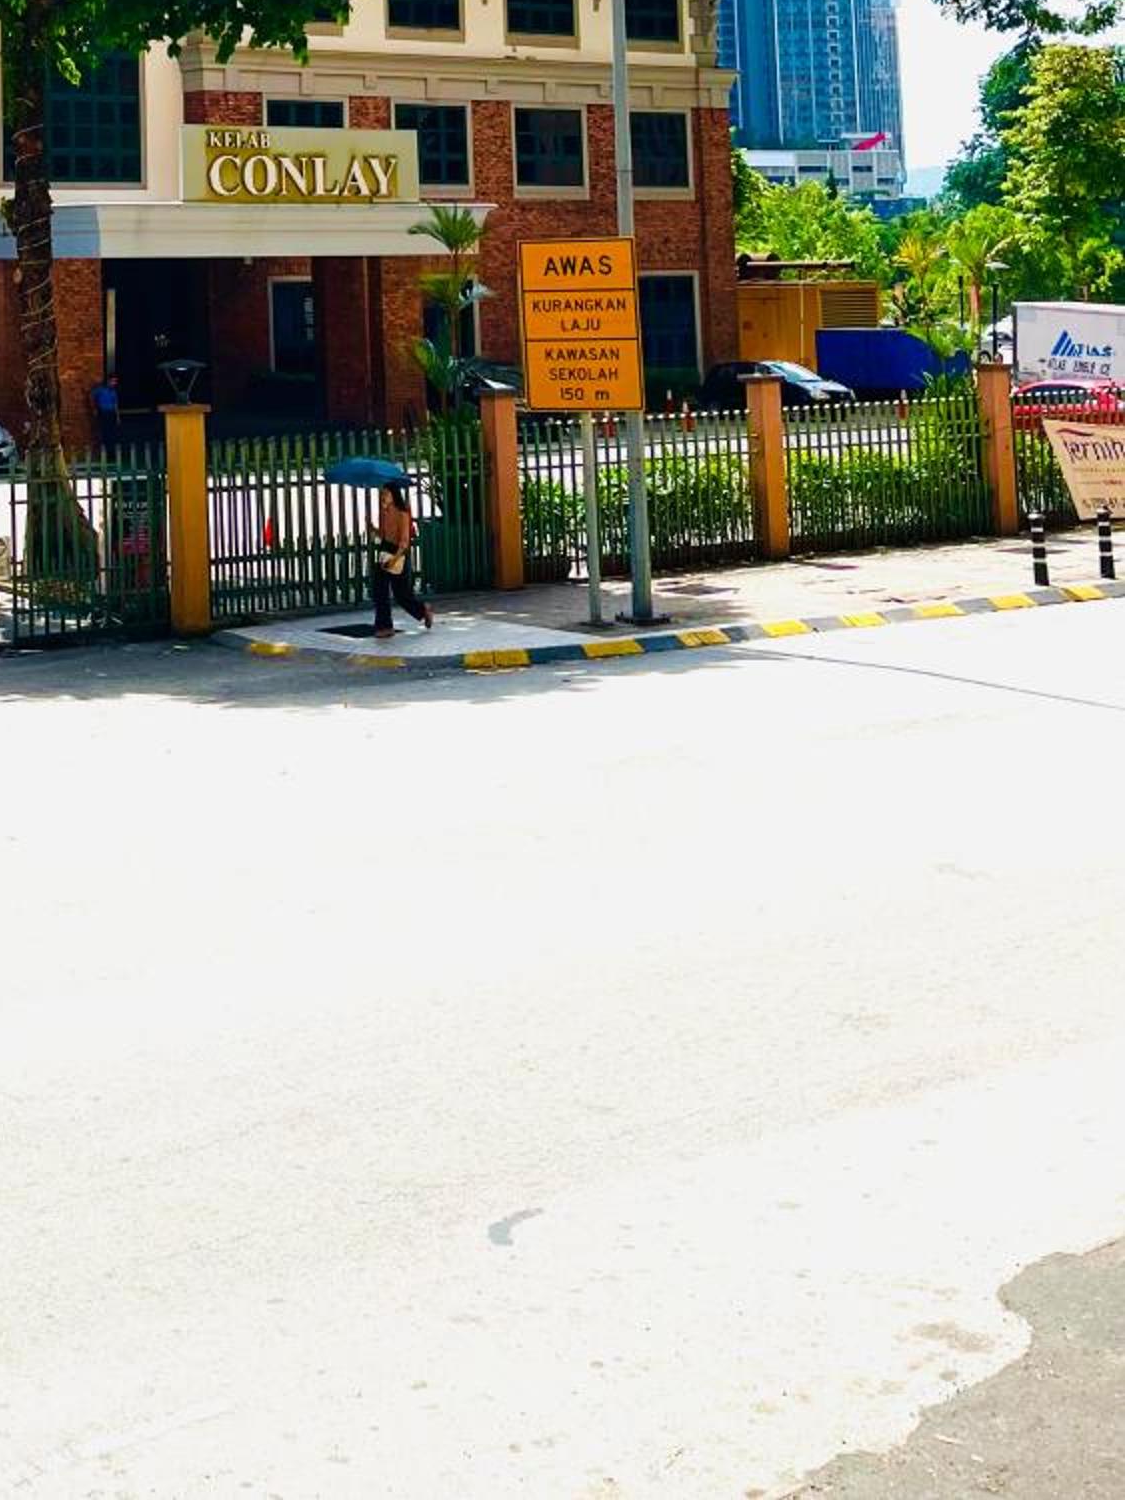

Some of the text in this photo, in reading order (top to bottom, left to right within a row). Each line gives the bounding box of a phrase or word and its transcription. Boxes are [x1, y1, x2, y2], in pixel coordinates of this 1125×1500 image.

[207, 130, 271, 149] KELAB
[207, 153, 397, 198] CONLAY
[544, 255, 613, 277] AWAS
[532, 298, 627, 313] KURANGKAN
[560, 318, 601, 332] LAJU
[545, 348, 620, 362] KAWASAN
[549, 367, 619, 382] SEKOLAH
[560, 387, 610, 401] 150 m
